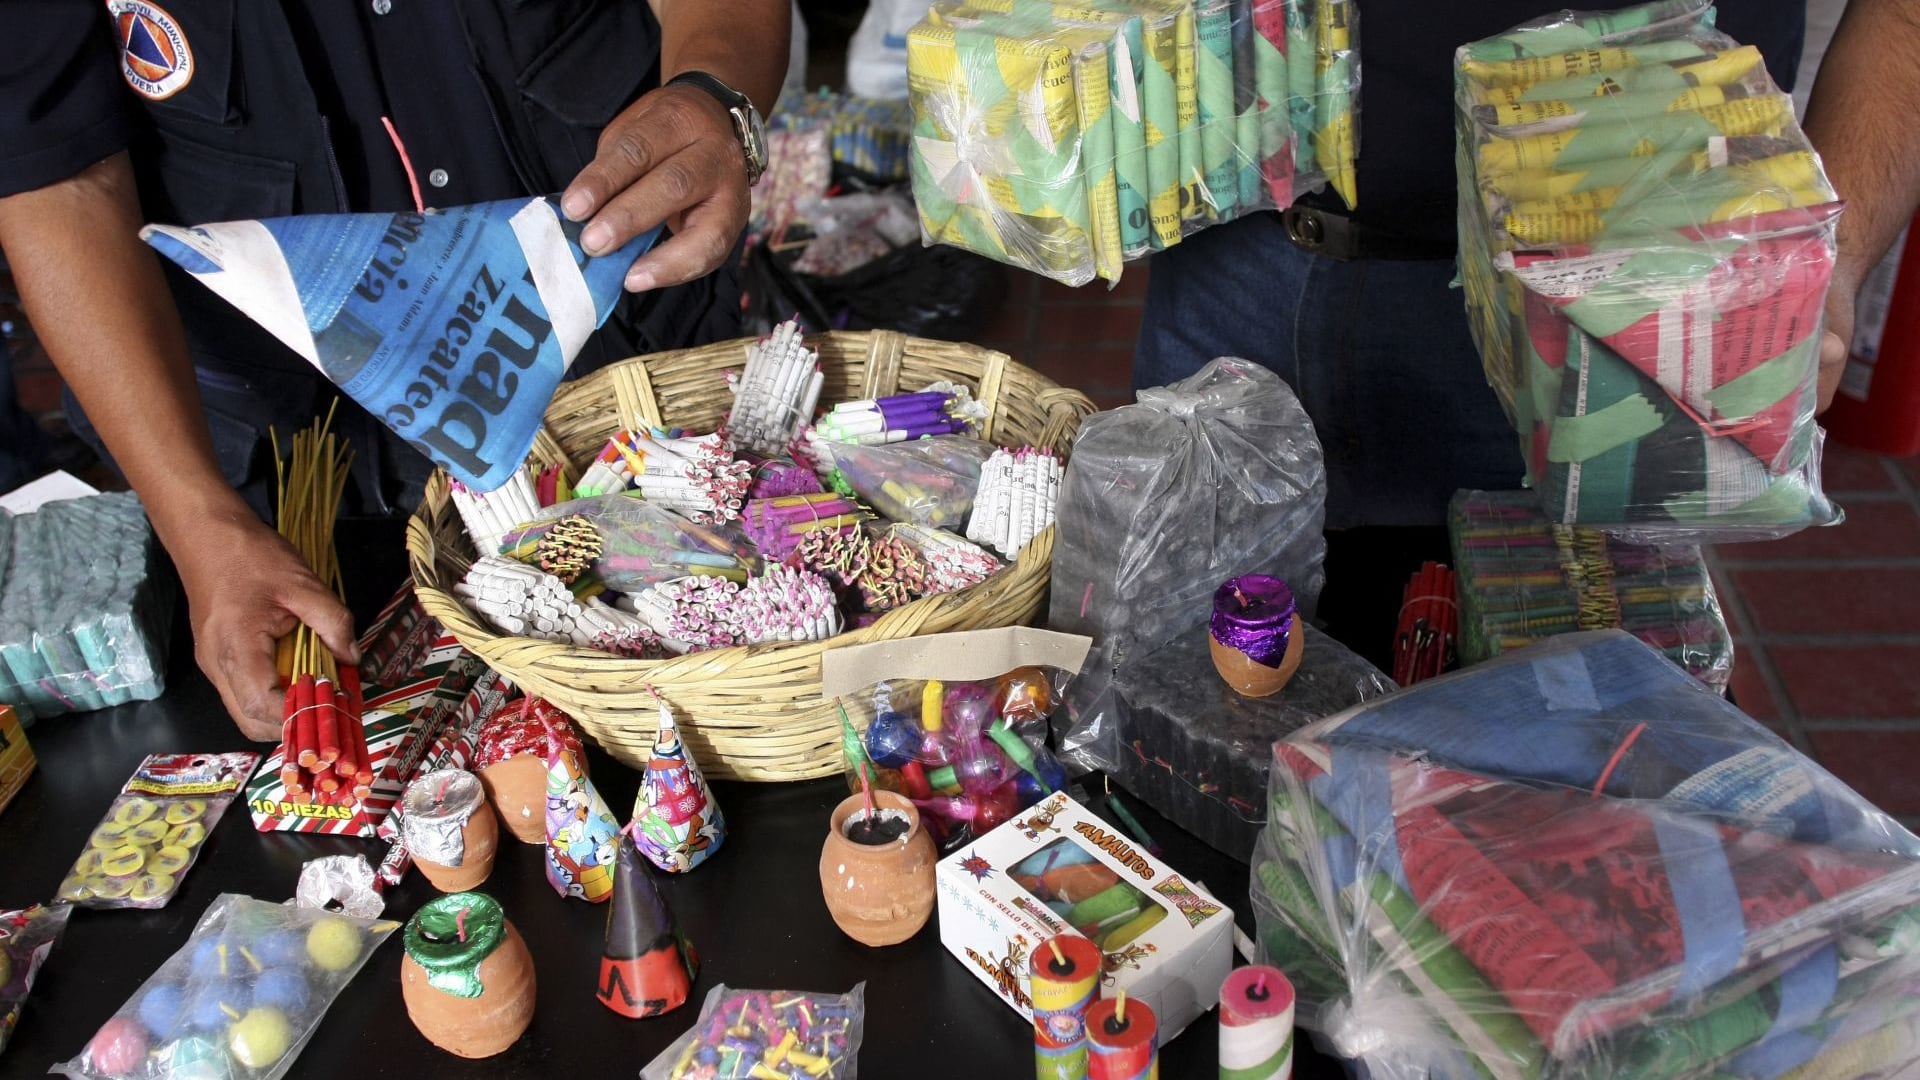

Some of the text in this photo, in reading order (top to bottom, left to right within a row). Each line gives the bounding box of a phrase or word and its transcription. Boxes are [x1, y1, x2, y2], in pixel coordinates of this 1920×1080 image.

[125, 2, 188, 71] CIVIL MUNICIPAL
[126, 68, 164, 94] PUEBLA
[397, 698, 449, 783] ESCUPIDOR
[253, 800, 353, 820] 10 PIEZAS
[1073, 820, 1155, 881] TAMALITOS
[978, 888, 996, 905] CON
[996, 902, 1022, 922] SELLO
[1020, 920, 1034, 933] DE
[964, 946, 1034, 1010] TAMALITO
